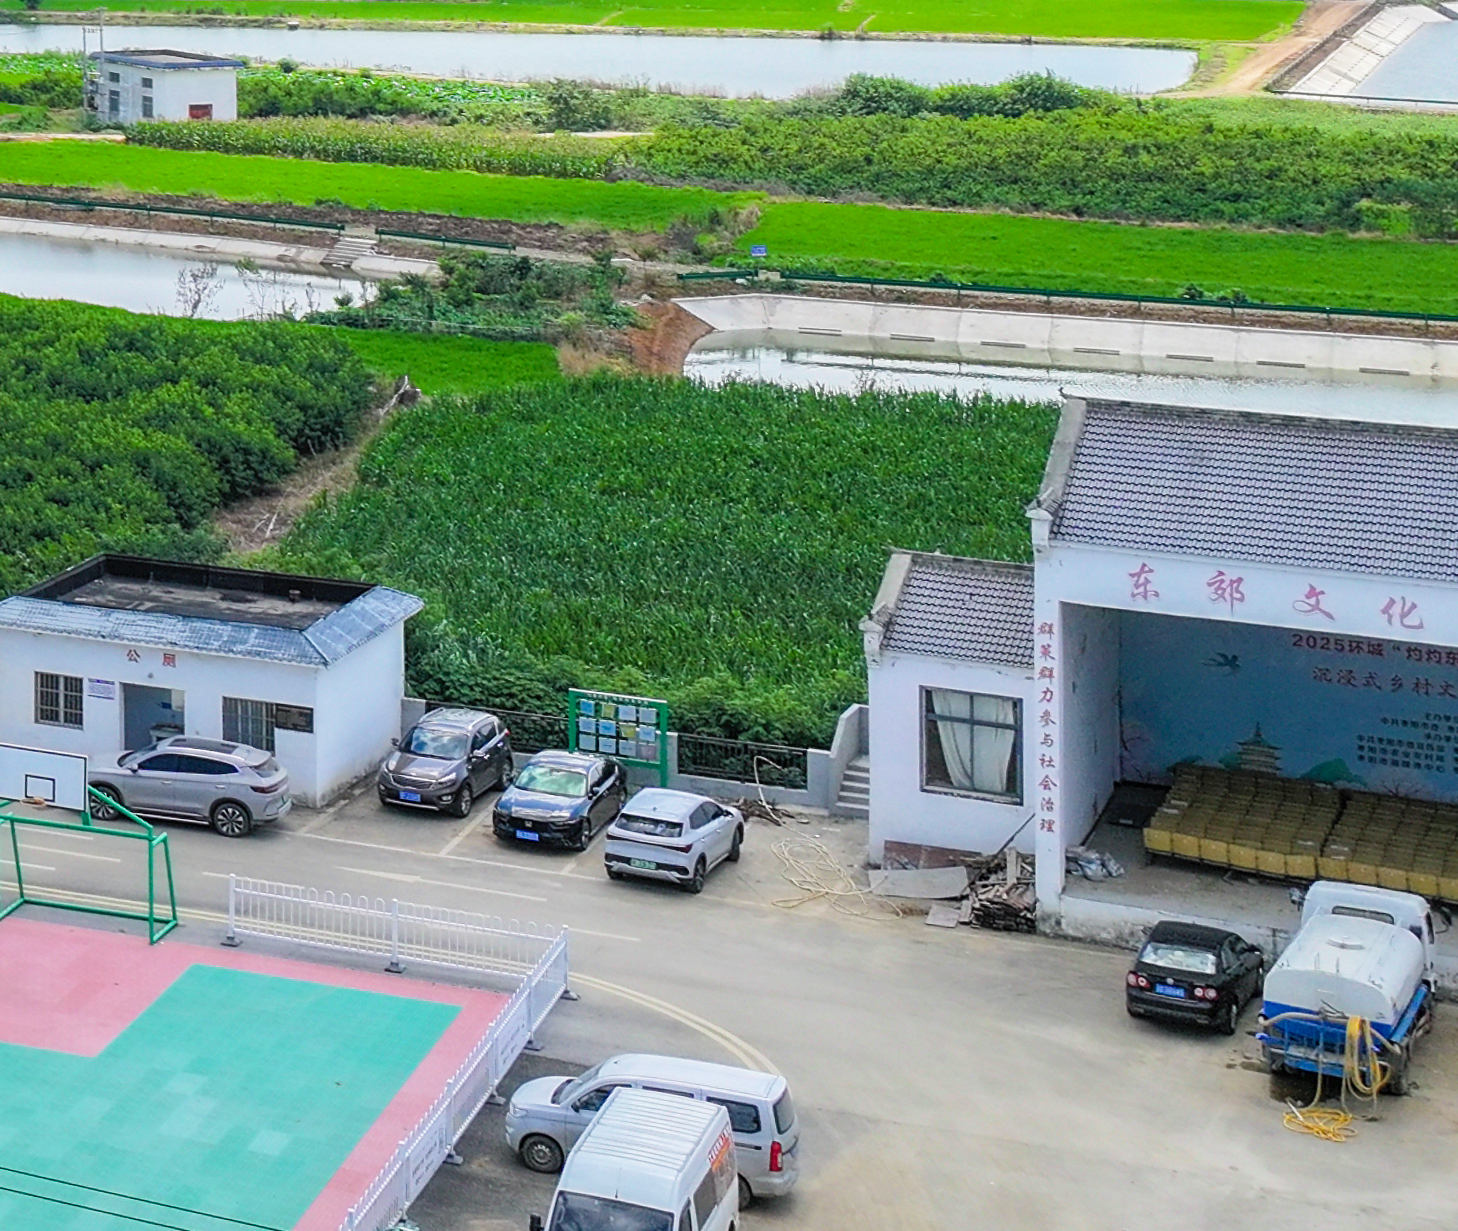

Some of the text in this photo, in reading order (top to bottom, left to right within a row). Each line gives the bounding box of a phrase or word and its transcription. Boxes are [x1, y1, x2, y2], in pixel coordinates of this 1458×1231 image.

[1127, 562, 1425, 631] 东郊文化
[1037, 621, 1058, 834] 群策群力参与社会治理
